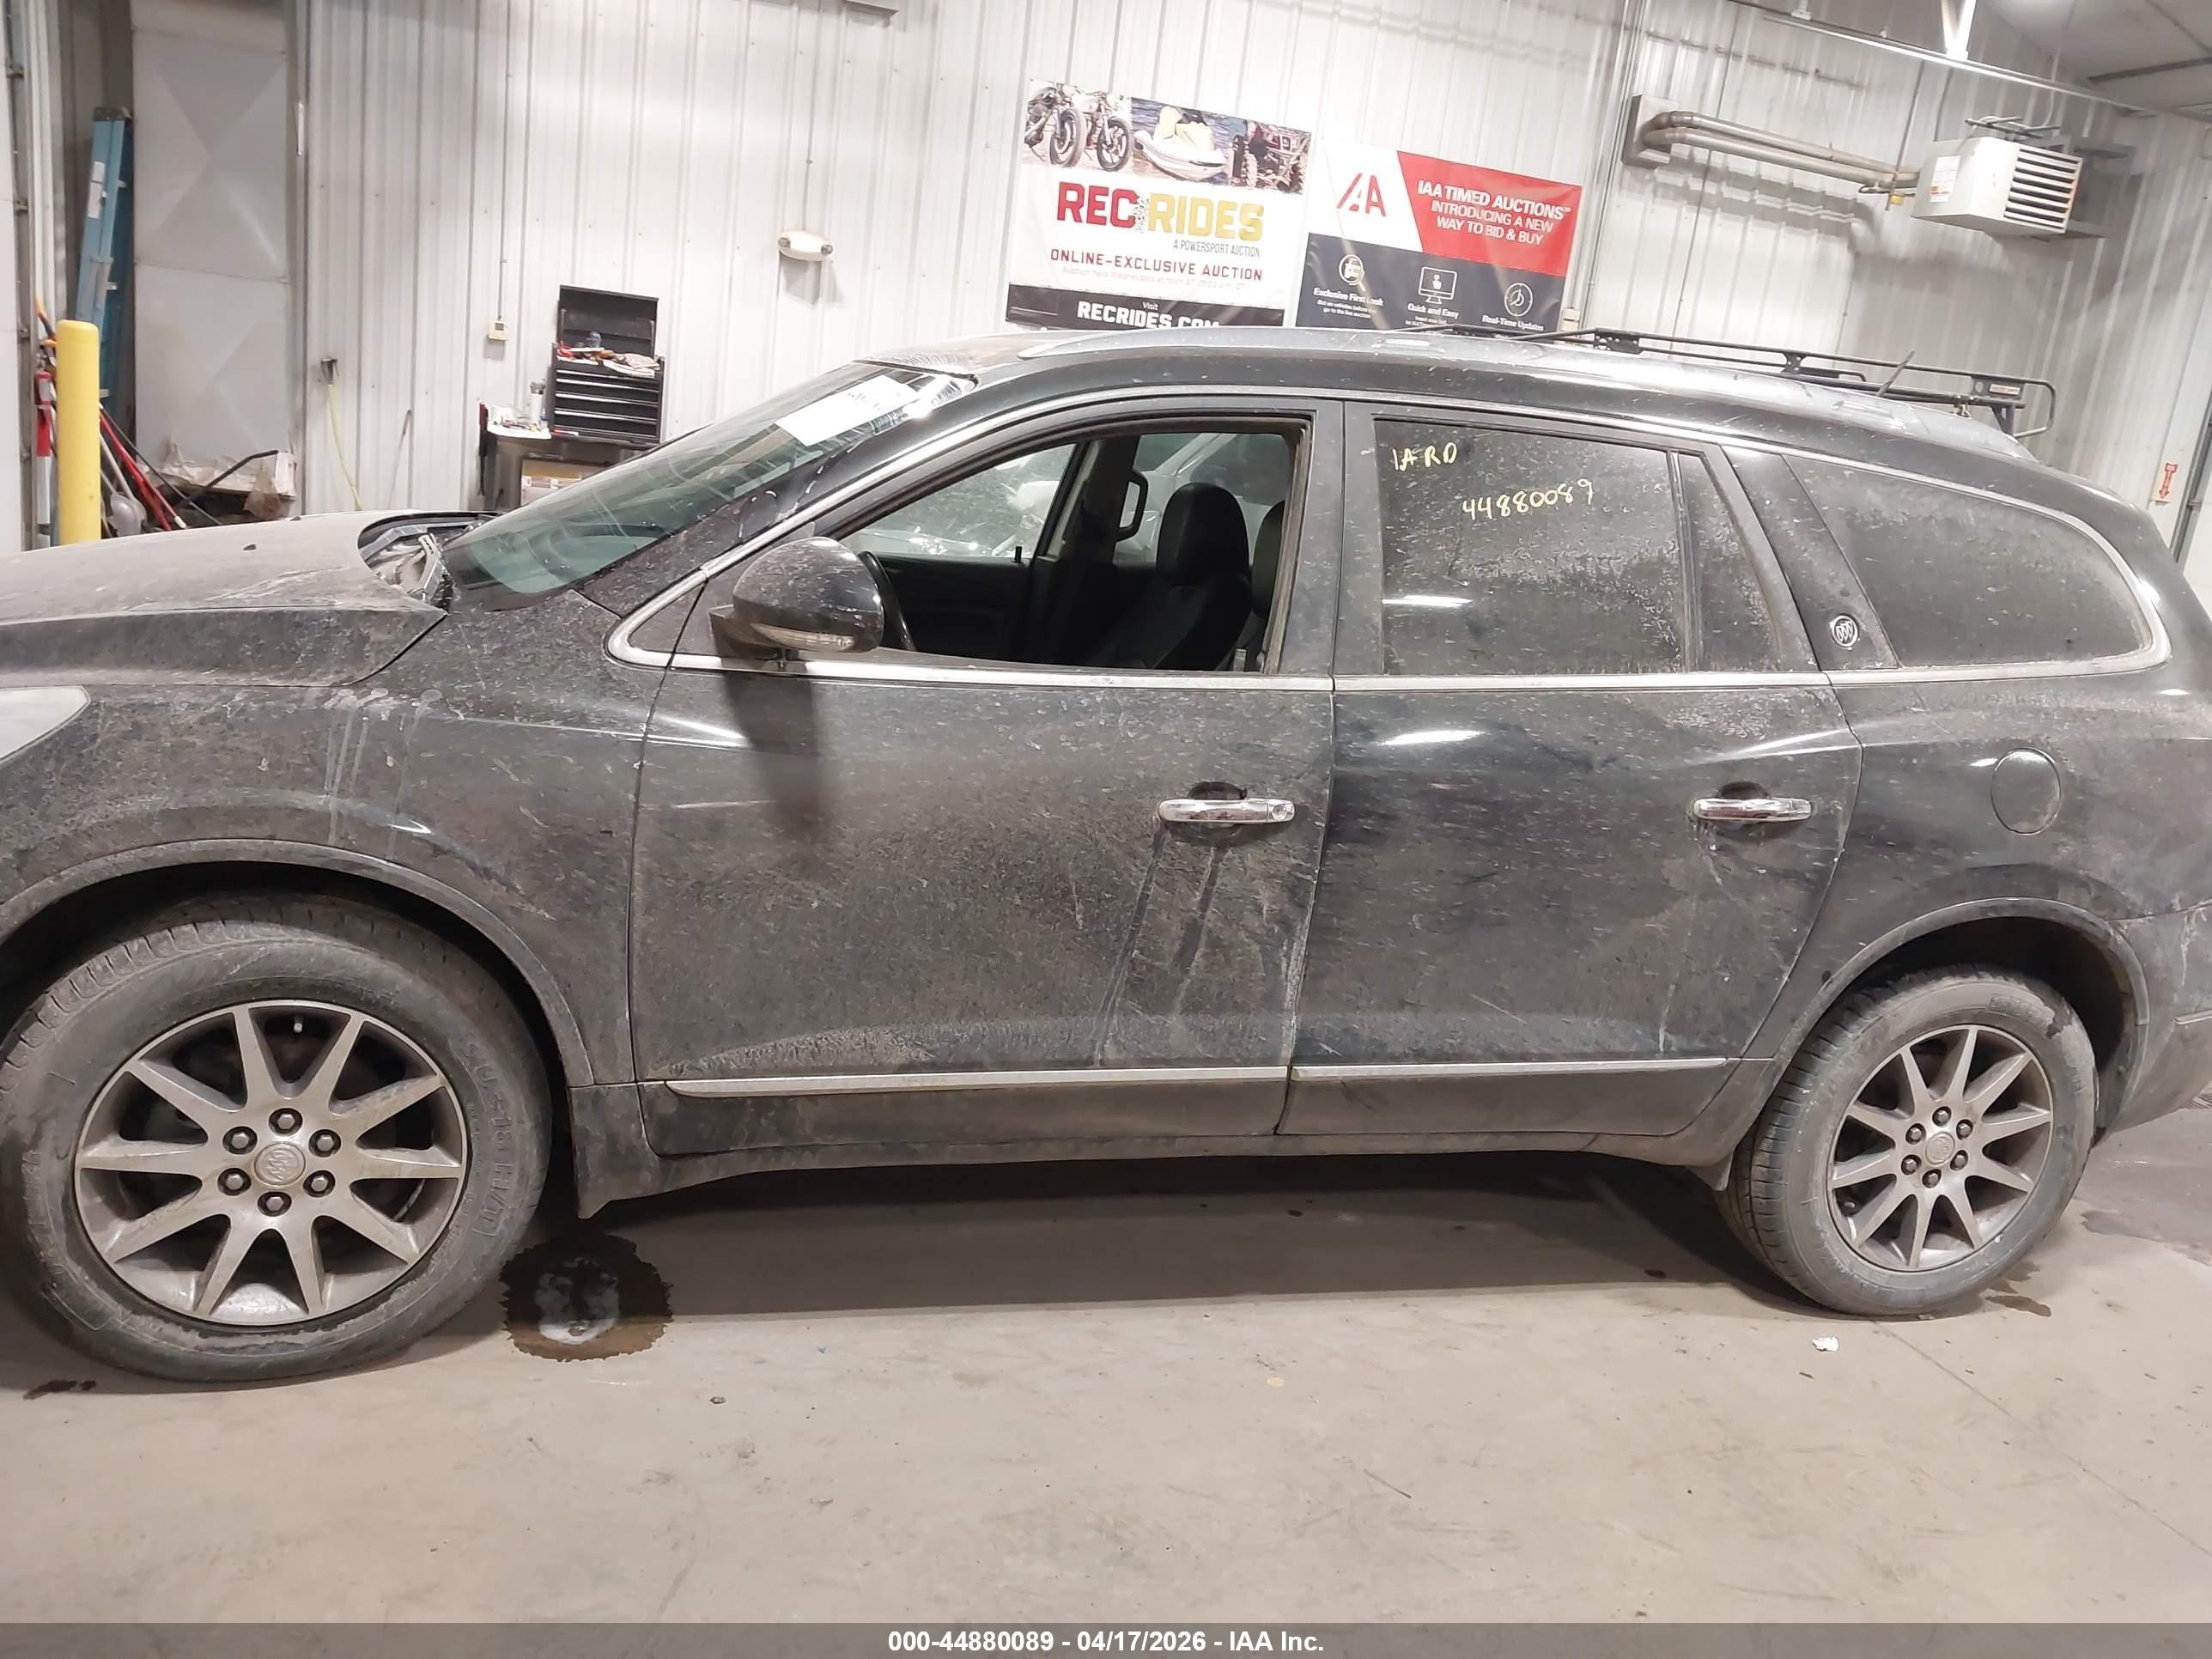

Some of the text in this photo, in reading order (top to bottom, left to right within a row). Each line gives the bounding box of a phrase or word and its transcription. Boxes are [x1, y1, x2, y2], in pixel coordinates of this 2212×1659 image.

[1418, 179, 1443, 198] IAA
[1444, 185, 1491, 206] TIMED
[1147, 191, 1265, 242] RIDES
[1431, 199, 1555, 234] INTRODUCING A NEW
[1437, 215, 1544, 246] WAY TO BID & BUY
[1173, 240, 1261, 258] A POWERSPORT AUCTION
[1050, 248, 1263, 282] ONLINE-EXCLUSIVE AUCTION
[1142, 301, 1159, 311] Visit
[1313, 288, 1384, 307] Exclusive First Look
[1407, 302, 1460, 319] Quick and Easy
[1077, 301, 1220, 329] RECRIDESCO
[1482, 314, 1545, 332] Real-Time Updates
[1462, 478, 1593, 520] 44880089
